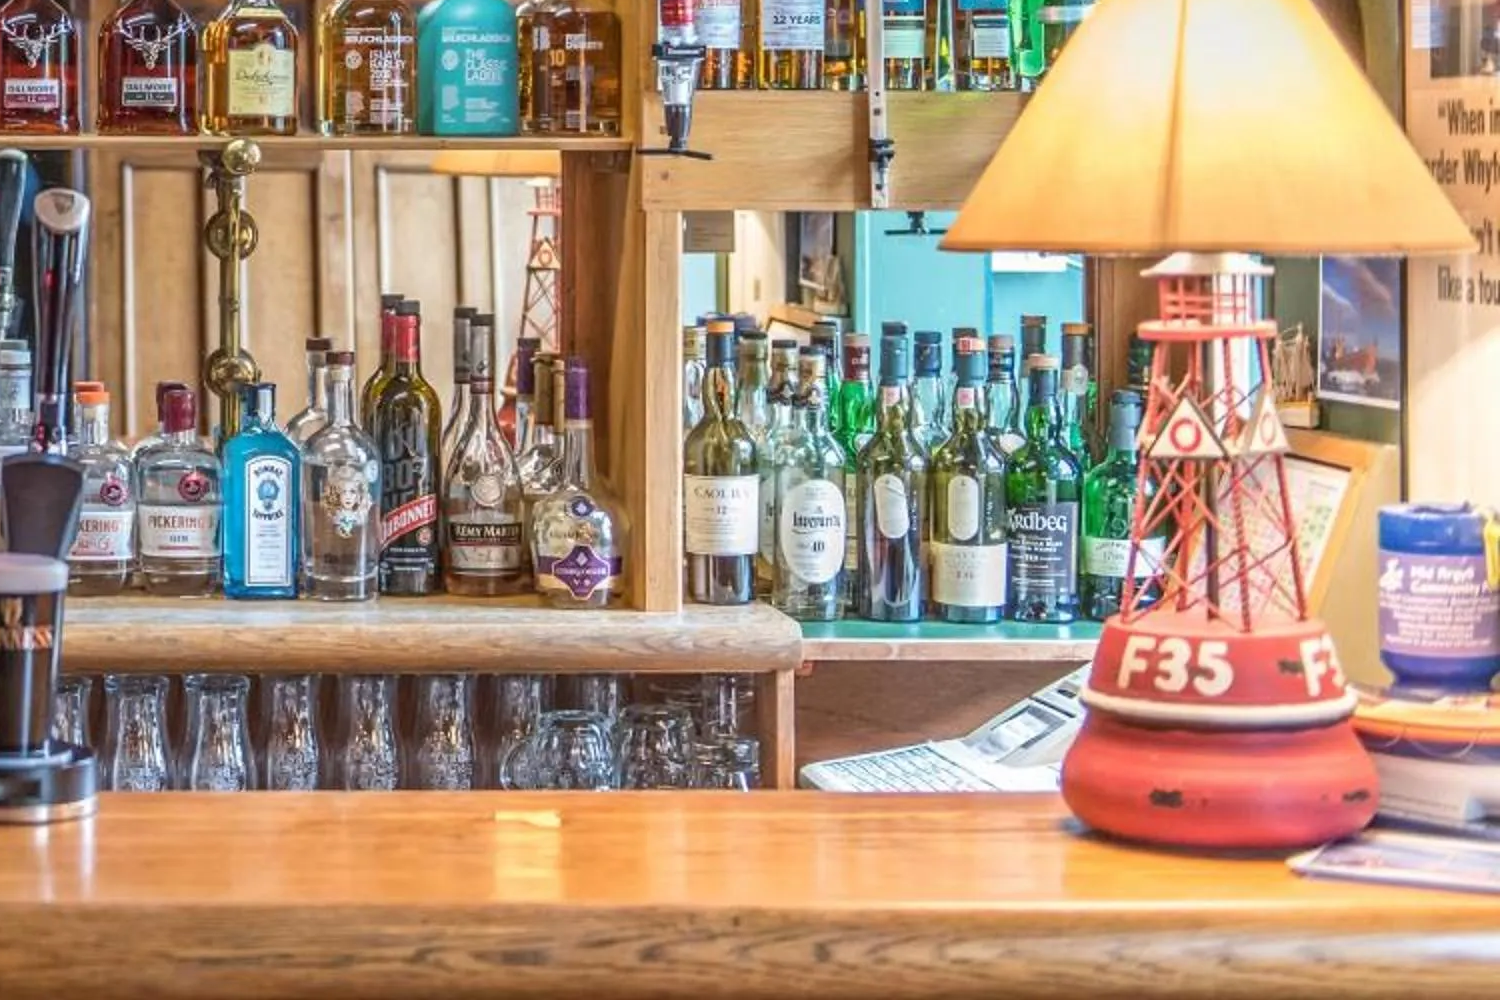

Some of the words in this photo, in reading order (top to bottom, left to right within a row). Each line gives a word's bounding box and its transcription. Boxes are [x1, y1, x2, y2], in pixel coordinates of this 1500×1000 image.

[772, 14, 787, 25] 12
[789, 14, 821, 25] YEARS
[549, 48, 566, 67] 10
[7, 83, 55, 94] DALMORE
[125, 82, 172, 93] DALMORE
[1437, 264, 1462, 301] like
[1466, 278, 1475, 302] a
[252, 462, 284, 476] BOMBAY
[251, 508, 285, 521] SAPPHIRE
[812, 542, 827, 556] 10
[1117, 635, 1235, 697] F35
[1300, 637, 1349, 697] F3
